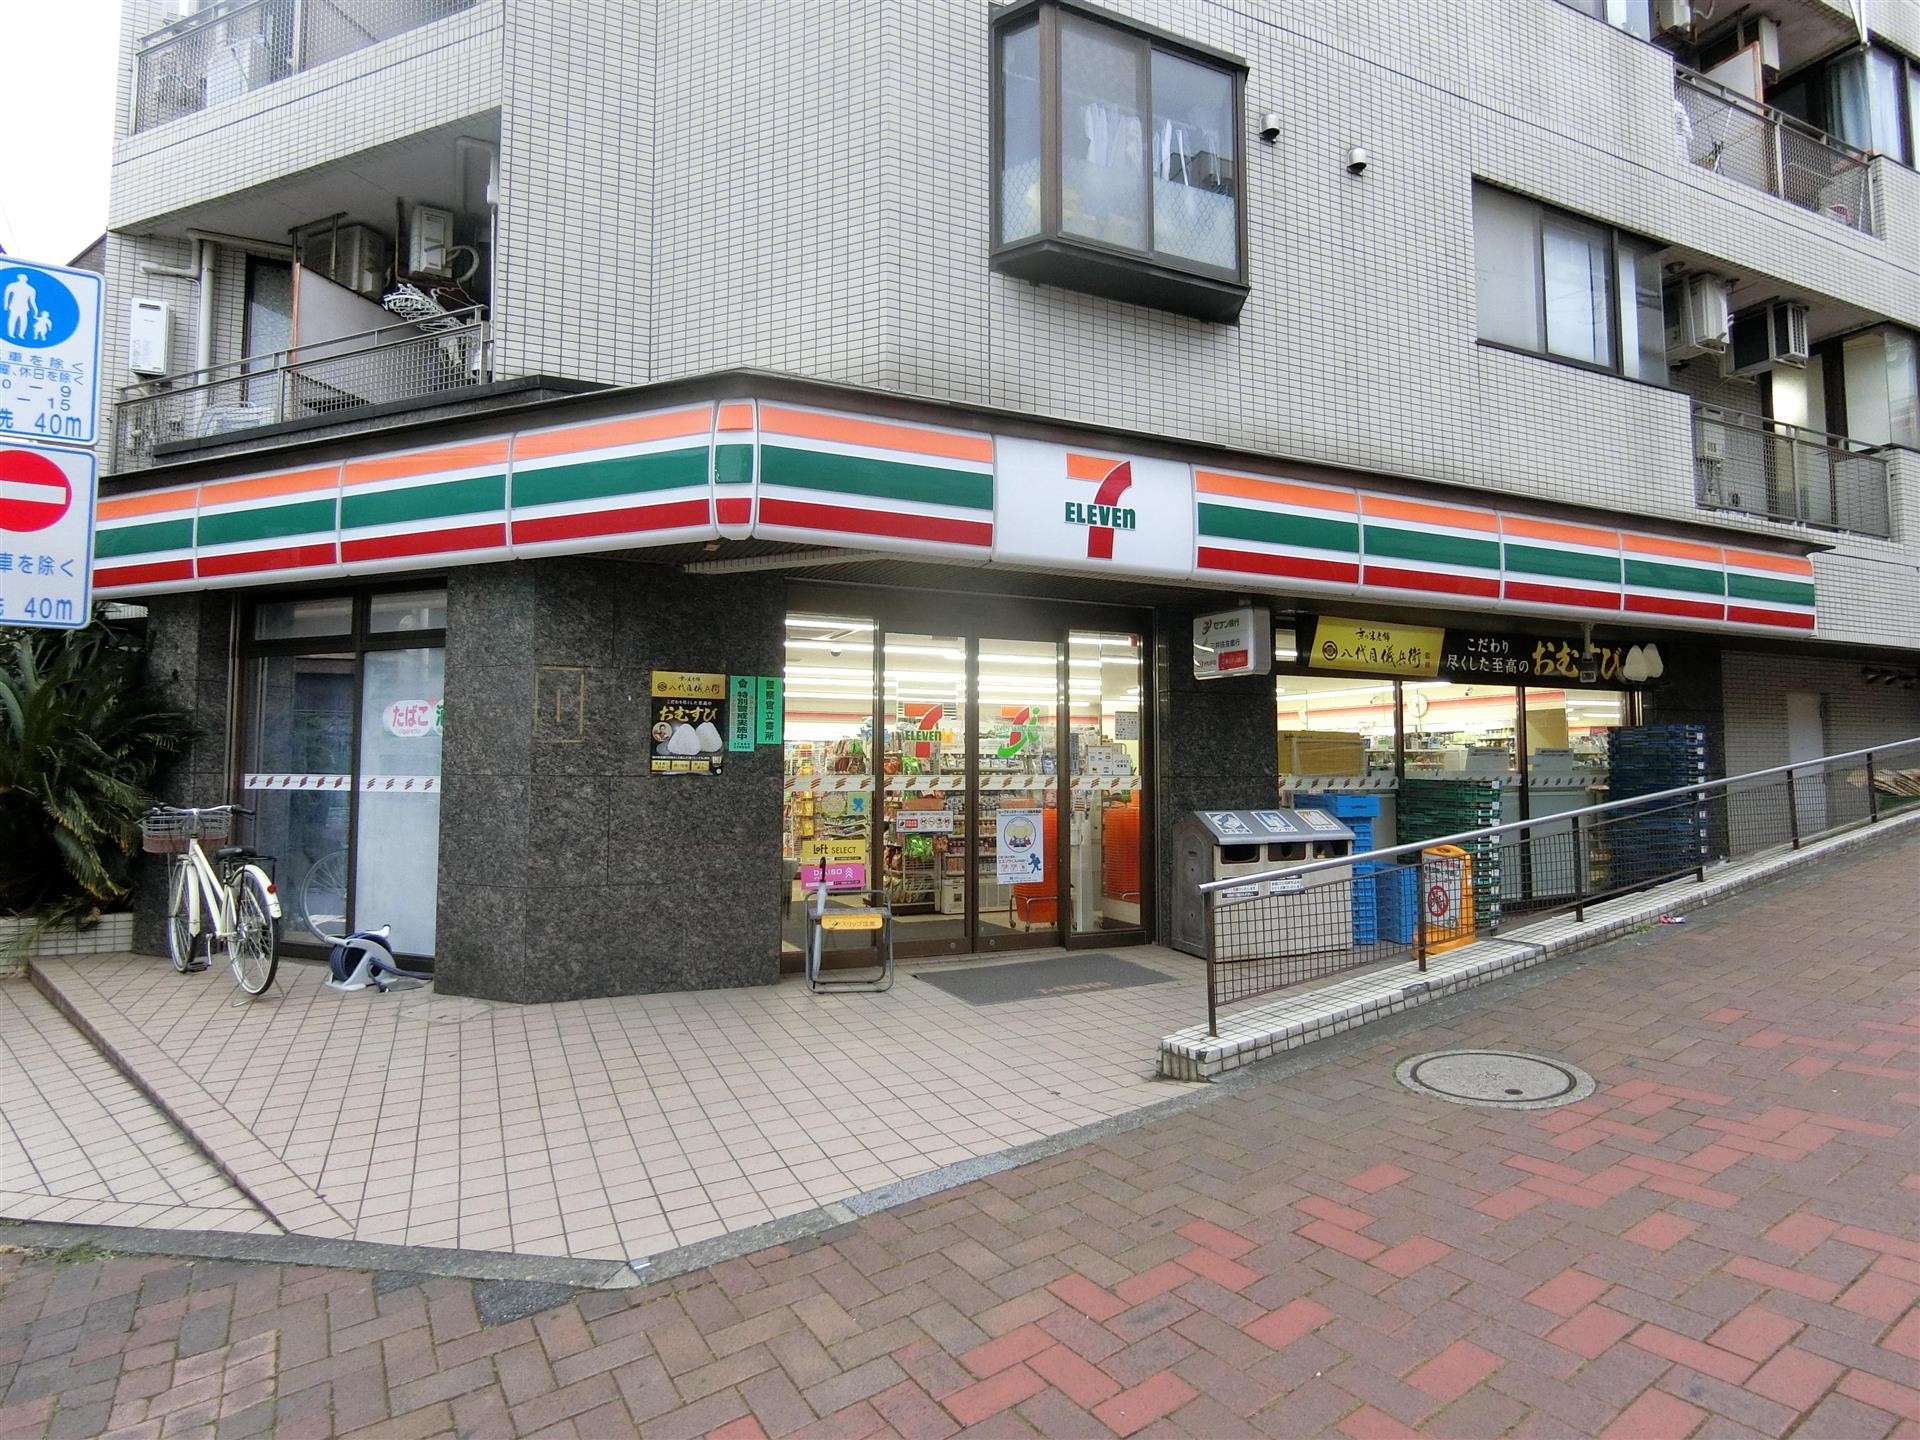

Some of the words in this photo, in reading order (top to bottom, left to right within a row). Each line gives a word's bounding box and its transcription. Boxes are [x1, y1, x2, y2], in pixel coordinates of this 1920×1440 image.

[34, 412, 82, 438] 40m
[24, 597, 73, 621] 40m
[1467, 638, 1509, 654] こだわり
[1446, 654, 1529, 674] 尽くした至高の
[392, 705, 429, 727] たばこ
[831, 846, 857, 854] SELECT
